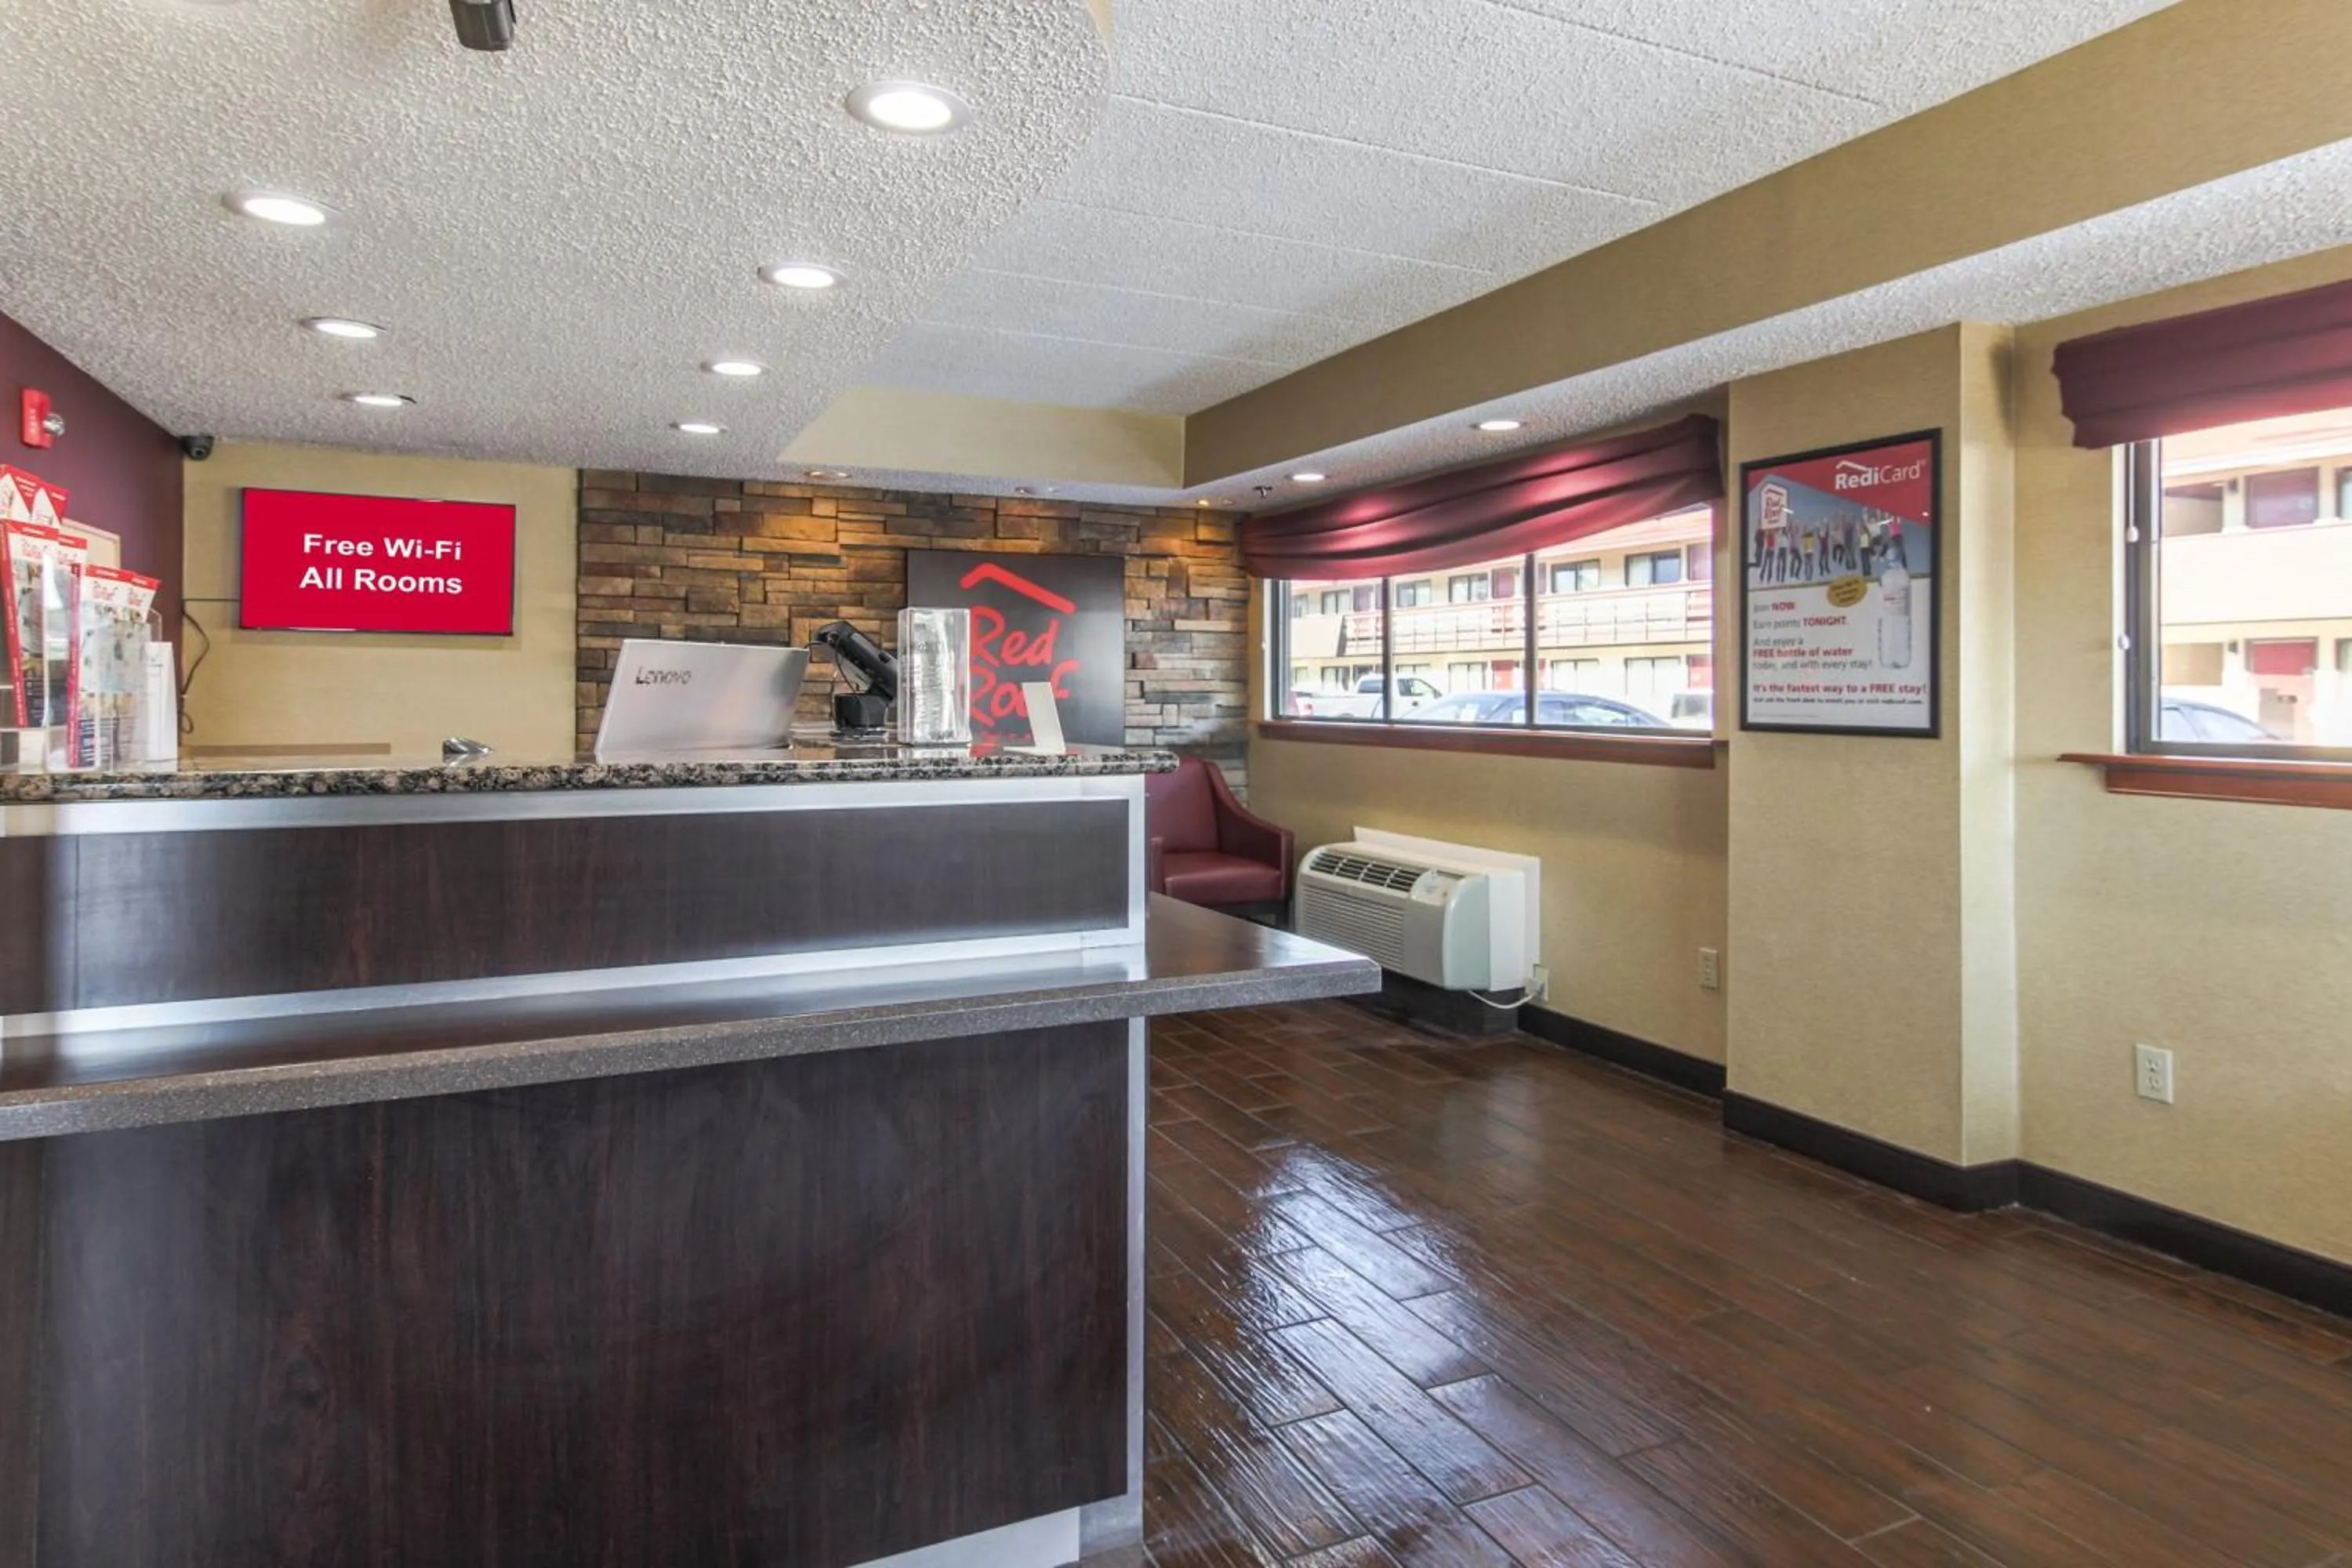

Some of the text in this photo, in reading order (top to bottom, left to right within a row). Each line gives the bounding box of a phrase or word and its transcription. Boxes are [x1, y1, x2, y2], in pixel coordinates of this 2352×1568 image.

[303, 533, 462, 561] Free Wi-Fi
[299, 566, 463, 594] All Rooms
[1772, 601, 1795, 611] NOW
[970, 604, 1059, 667] Red
[1753, 647, 1853, 659] FREE bottle of water
[635, 666, 691, 685] Lenovo
[970, 659, 1080, 728] Rof
[1769, 684, 1784, 693] the
[1786, 684, 1820, 693] fastest
[1823, 685, 1843, 695] way
[1846, 684, 1858, 694] to
[1870, 684, 1894, 694] FREE
[1898, 684, 1927, 695] stay!
